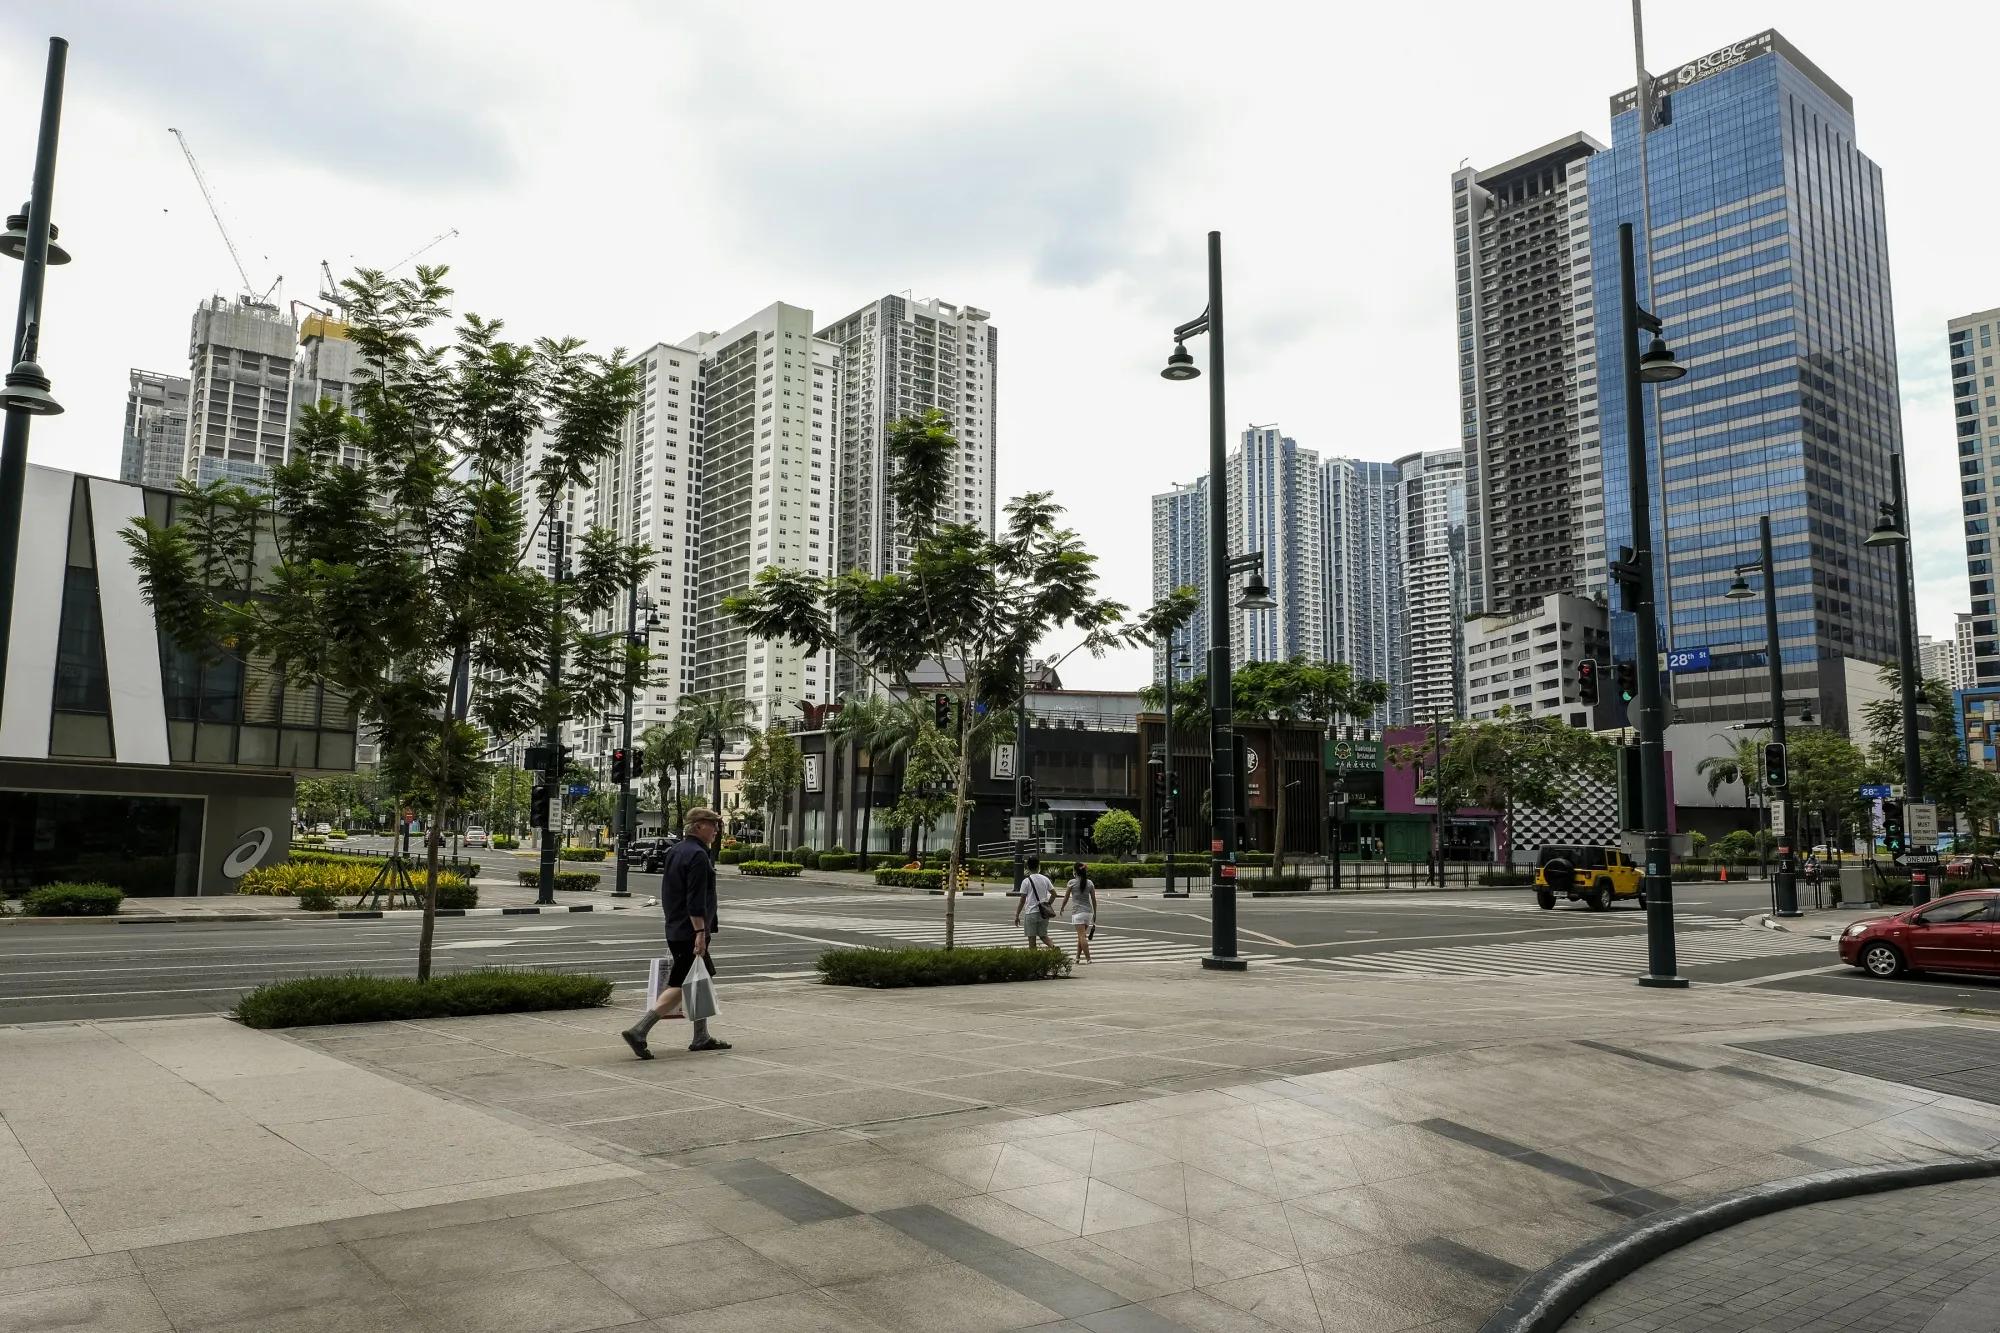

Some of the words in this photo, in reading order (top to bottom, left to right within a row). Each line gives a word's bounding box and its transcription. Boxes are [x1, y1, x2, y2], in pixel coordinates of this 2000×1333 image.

[1697, 41, 1746, 72] RCBC
[1698, 63, 1727, 78] Savings
[1728, 55, 1747, 67] Bank
[1670, 653, 1695, 667] 28th
[1699, 651, 1707, 659] St
